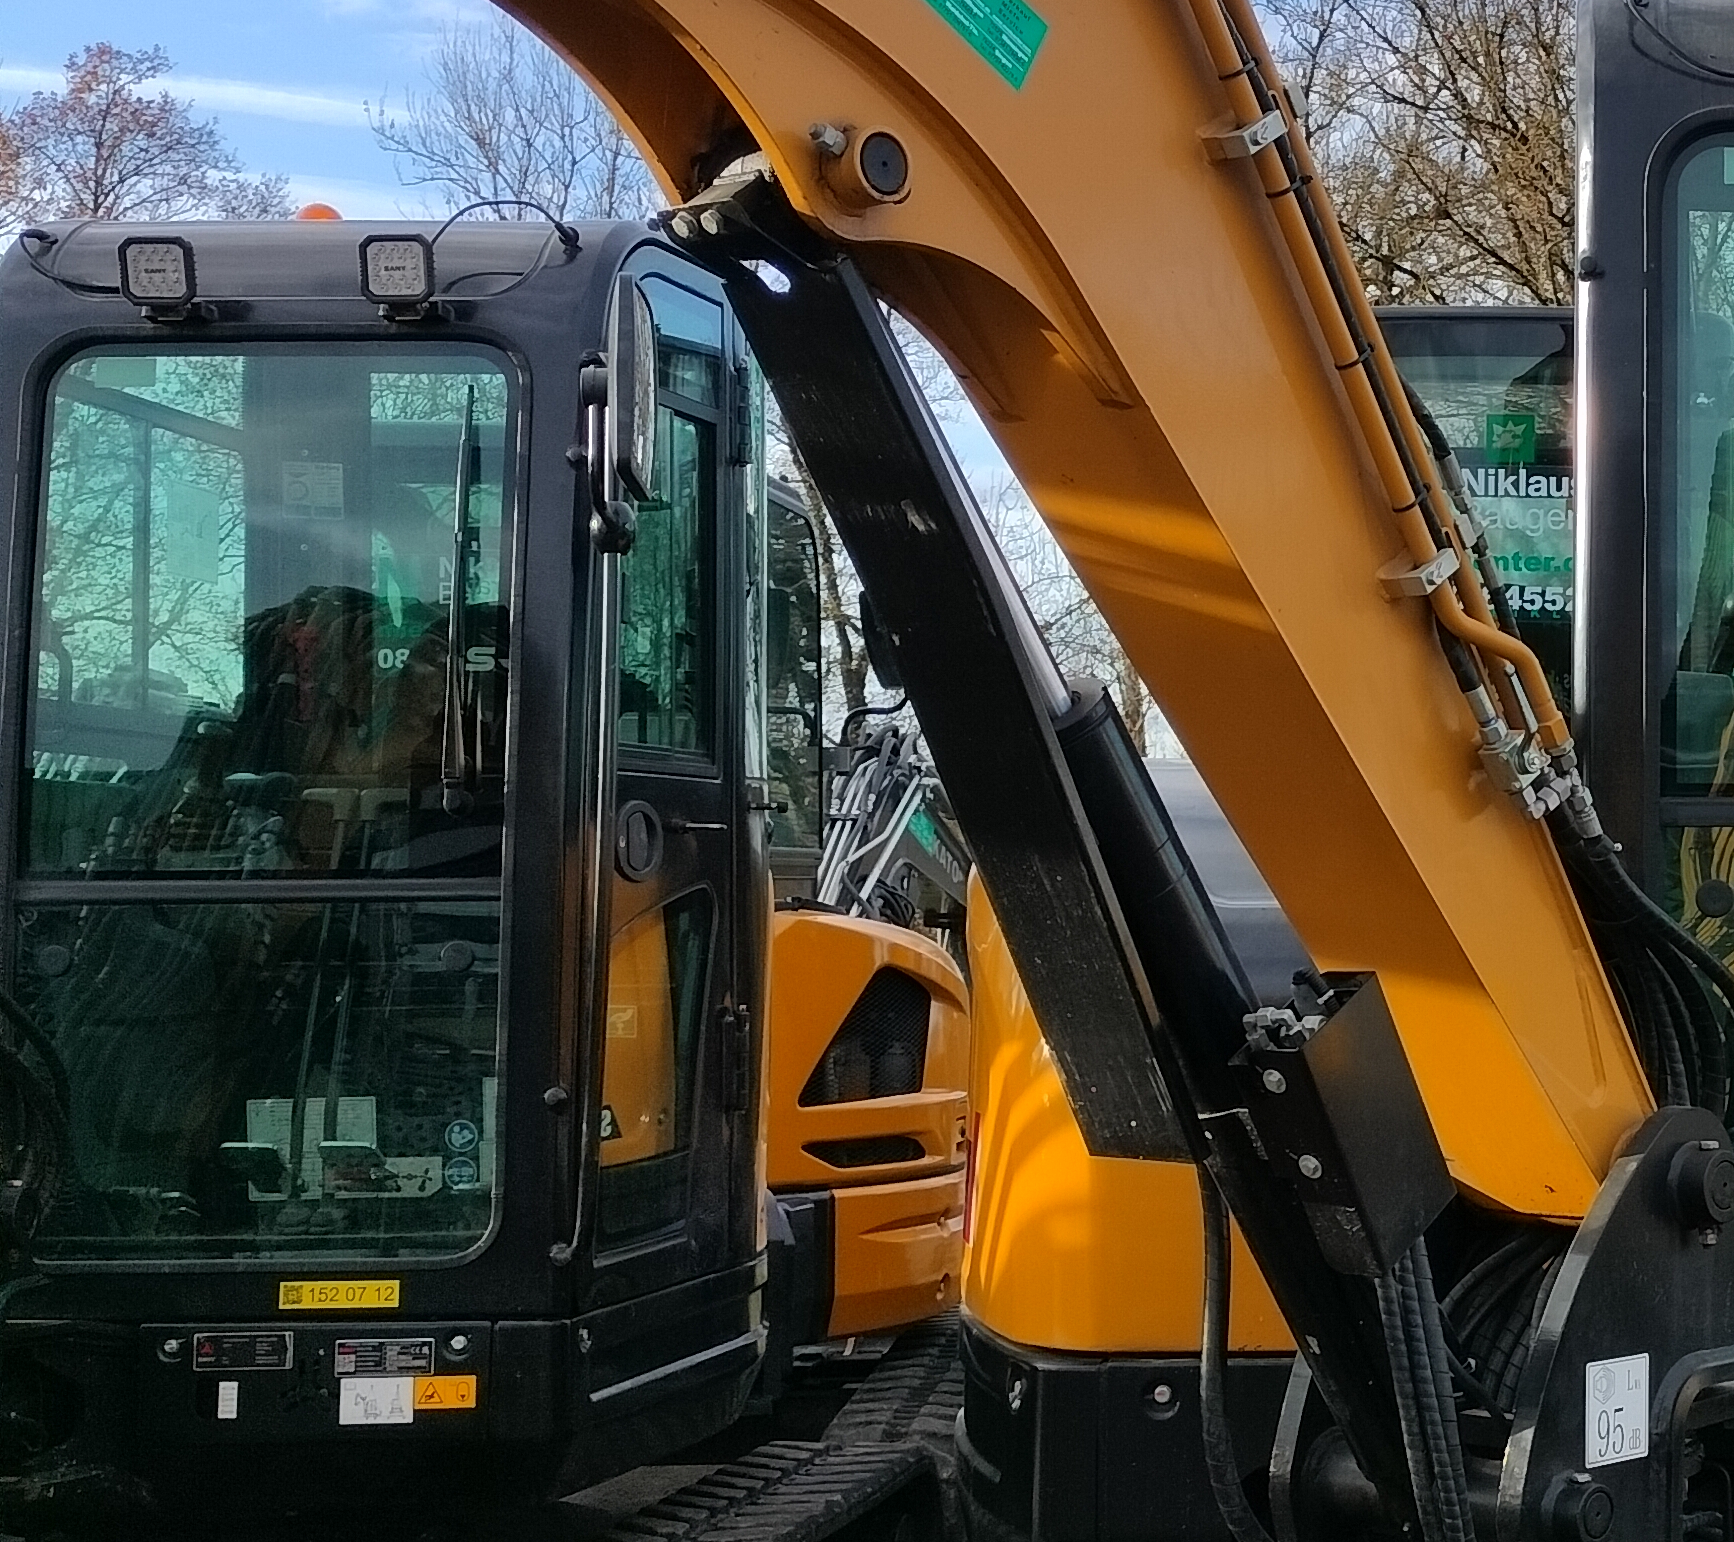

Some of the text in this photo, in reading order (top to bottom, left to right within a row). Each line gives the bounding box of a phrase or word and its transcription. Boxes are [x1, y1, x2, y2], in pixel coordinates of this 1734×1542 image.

[1462, 467, 1574, 497] Niklau
[308, 1285, 395, 1303] 152 07 12
[1597, 1406, 1625, 1458] 95
[1628, 1427, 1641, 1451] dB
